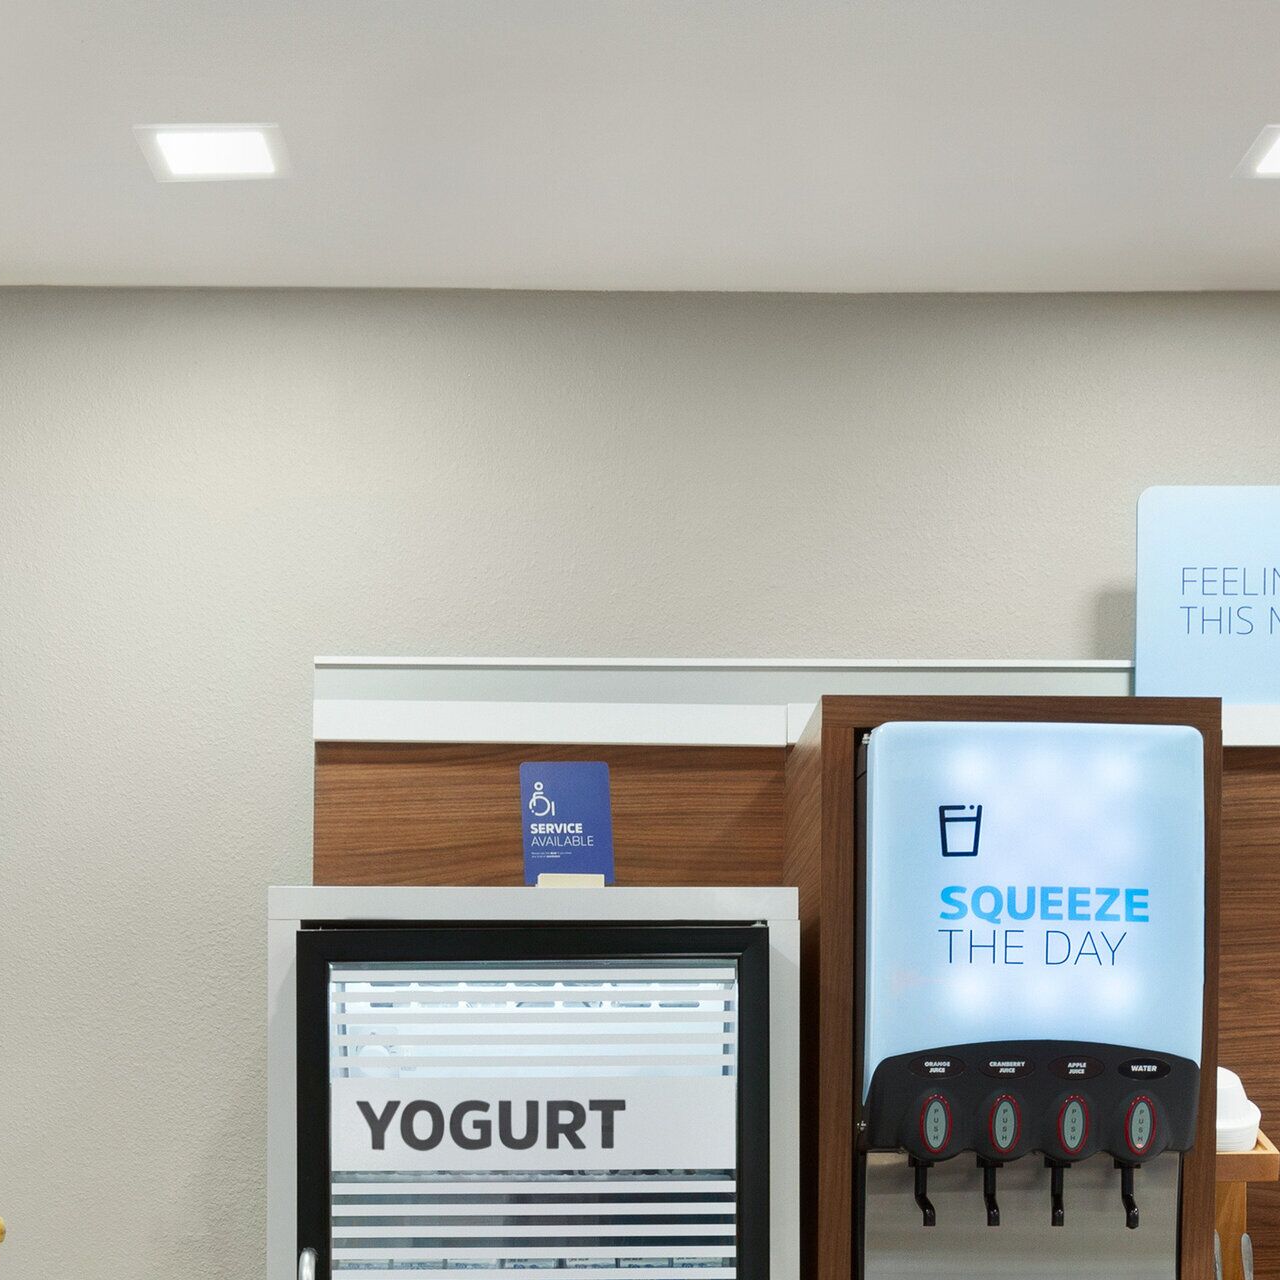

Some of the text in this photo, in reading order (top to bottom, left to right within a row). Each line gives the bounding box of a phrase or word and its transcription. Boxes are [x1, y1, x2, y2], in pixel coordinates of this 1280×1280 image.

[1180, 606, 1254, 635] THIS
[530, 823, 583, 834] SERVICE
[531, 836, 594, 847] AVAILABLE
[939, 885, 1150, 925] SQUEEZE
[938, 929, 1127, 966] THE DAY
[356, 1099, 627, 1152] YOGURT
